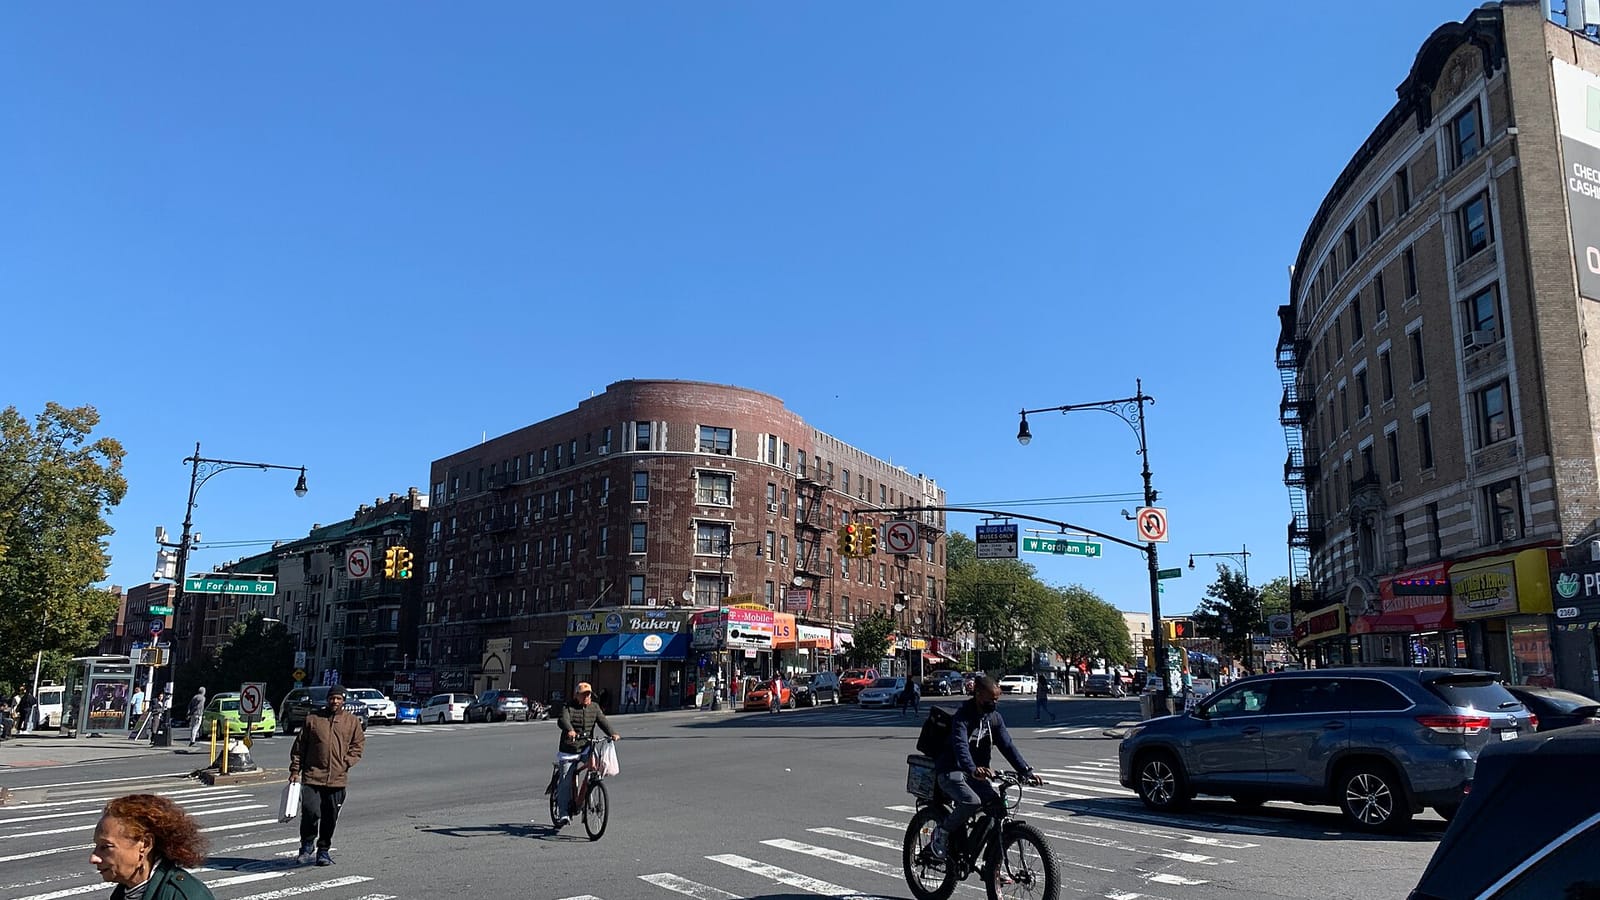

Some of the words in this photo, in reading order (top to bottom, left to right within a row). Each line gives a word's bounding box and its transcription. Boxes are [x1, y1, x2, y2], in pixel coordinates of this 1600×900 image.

[1573, 162, 1600, 183] CHEC
[1569, 177, 1600, 200] CASHI
[1030, 541, 1038, 550] W
[1041, 542, 1079, 553] Fordham
[1085, 545, 1096, 554] Rd
[193, 582, 202, 590] W
[206, 581, 249, 591] Fordham
[255, 583, 267, 592] Rd
[629, 617, 681, 633] Bakery
[773, 625, 790, 636] ILS
